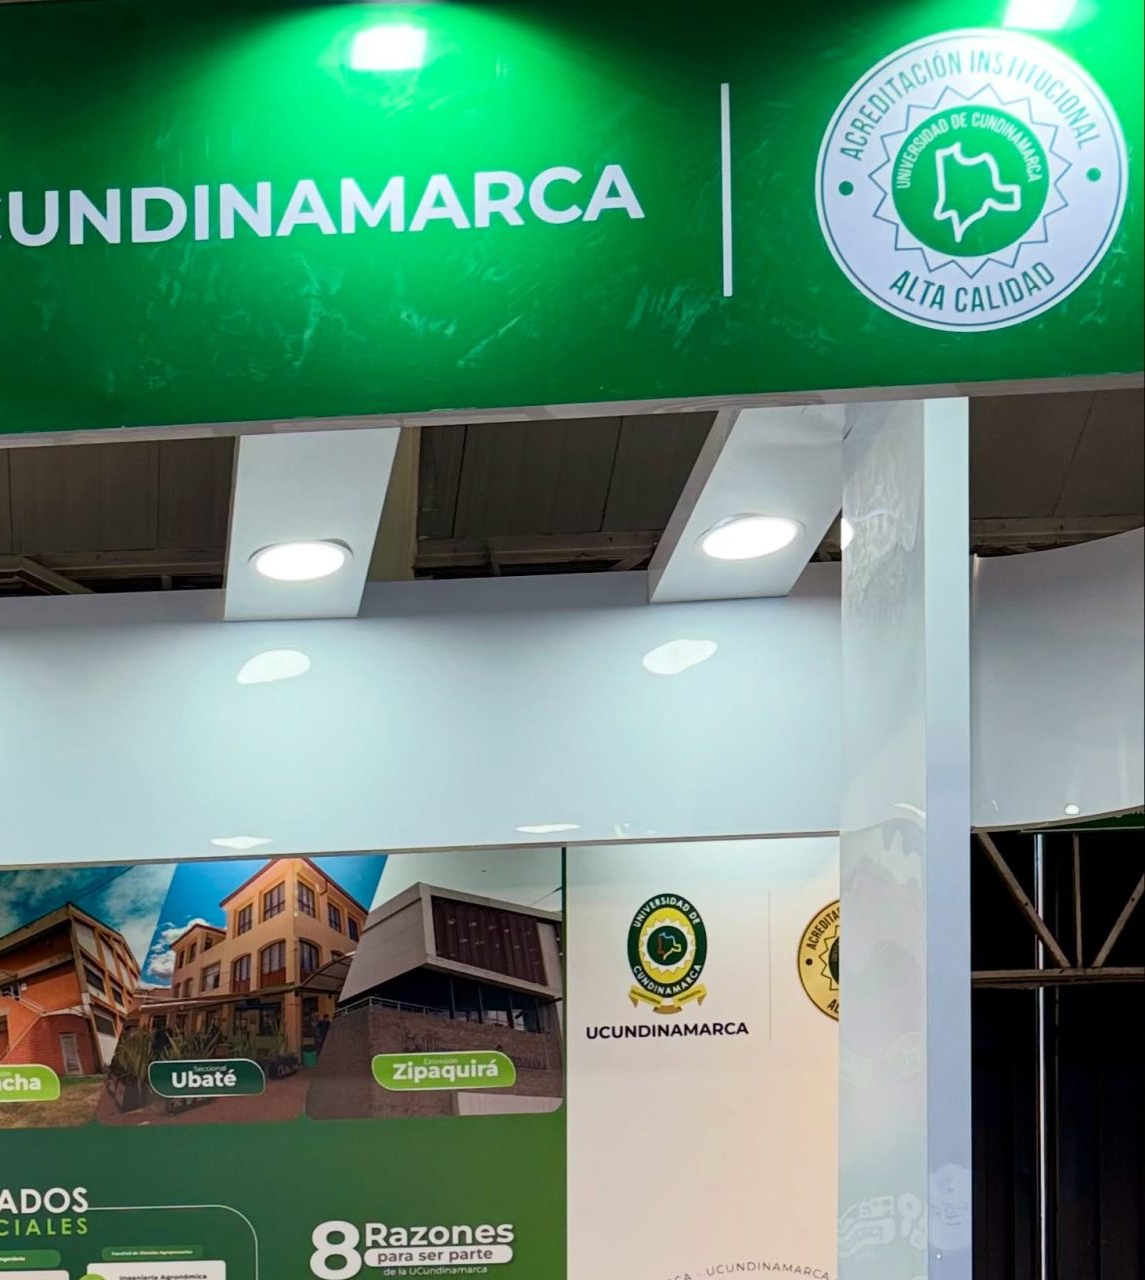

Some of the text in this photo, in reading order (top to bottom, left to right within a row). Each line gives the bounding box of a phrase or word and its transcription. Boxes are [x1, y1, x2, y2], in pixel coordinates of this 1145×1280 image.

[840, 49, 1101, 161] ACREDITACIÓN INSTITUCIONAL
[896, 112, 1043, 189] UNIVERSIDAD DE CUNDINAMARCA
[889, 261, 1055, 313] ALTA CALIDAD
[633, 897, 701, 928] UNIVERSIDAD DE
[634, 964, 702, 995] CUNDINAMARCA
[586, 1022, 749, 1039] UCUNDINAMARCA
[171, 1069, 237, 1088] Ubaté
[393, 1060, 499, 1082] Zipaquirá
[310, 1220, 514, 1280] 8 Razones
[377, 1248, 493, 1265] para ser parte
[383, 1265, 488, 1276] de la UCundinamarca
